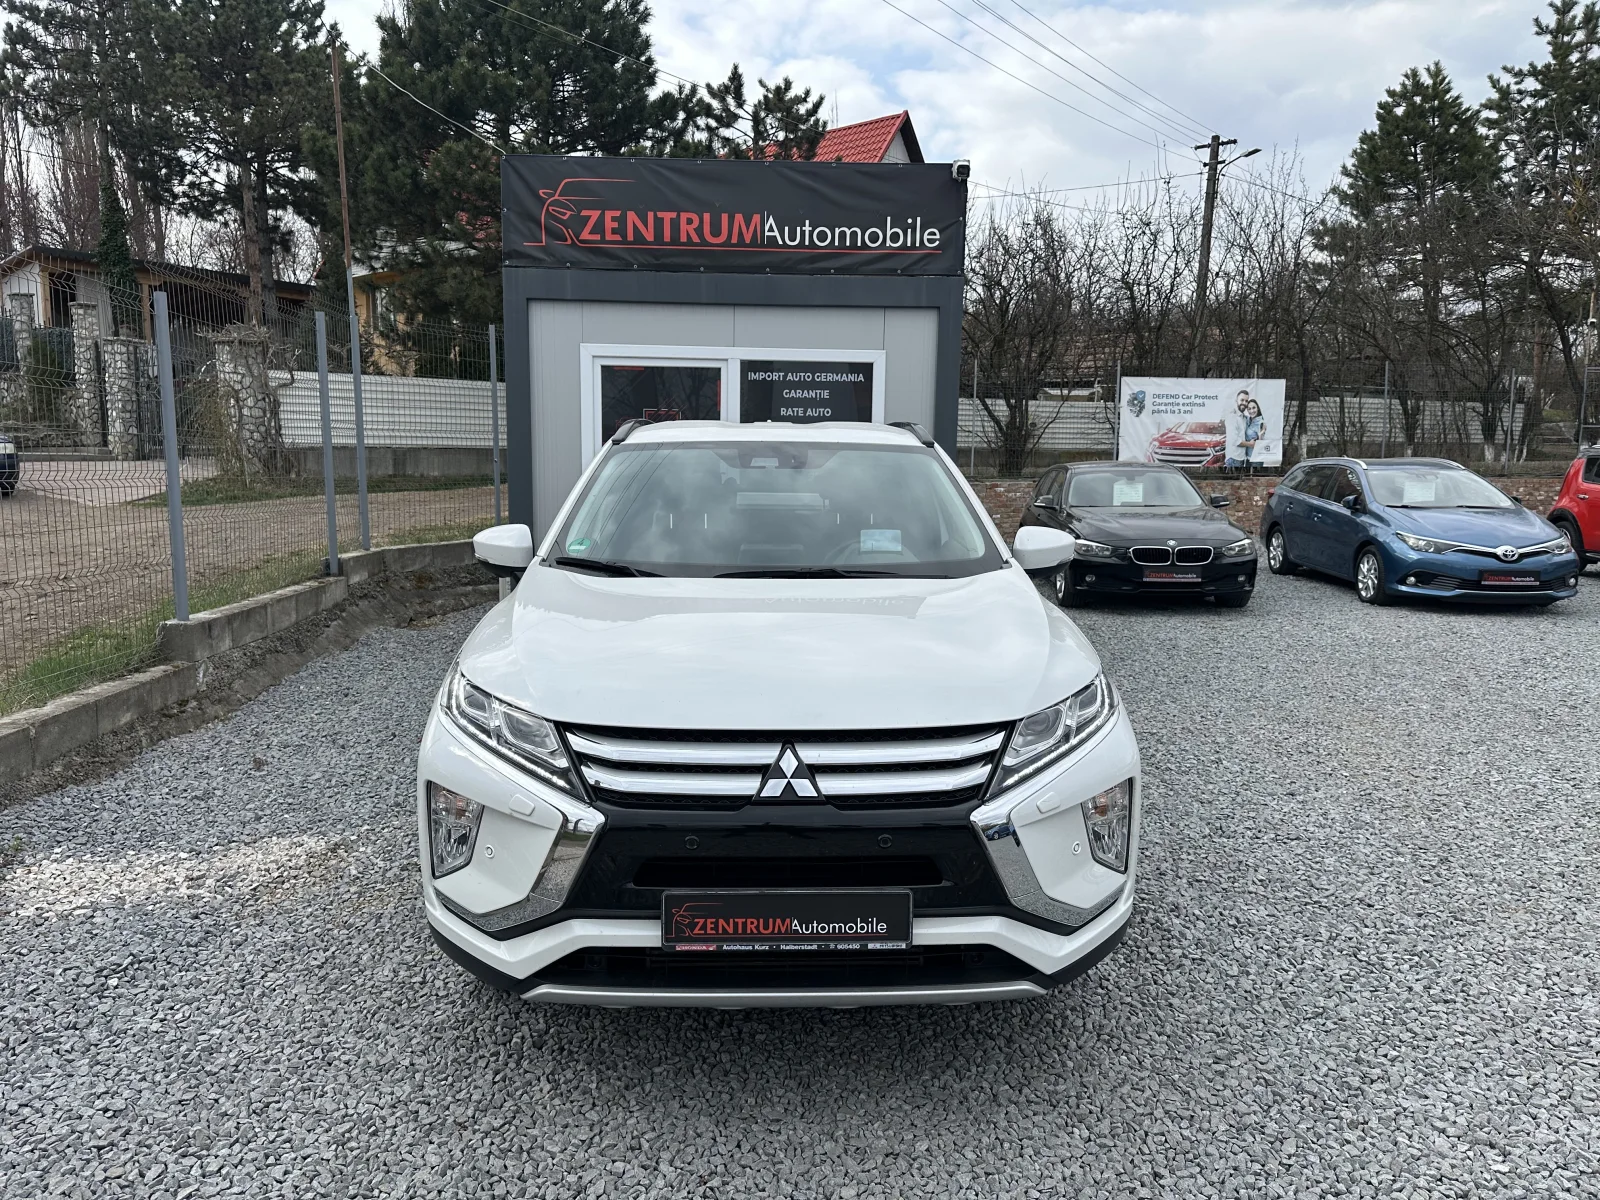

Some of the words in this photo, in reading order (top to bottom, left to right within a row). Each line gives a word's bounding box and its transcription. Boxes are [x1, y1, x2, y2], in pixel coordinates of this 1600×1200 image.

[748, 372, 784, 381] IMPORT
[786, 373, 812, 382] AUTO
[814, 373, 865, 382] GERMANIA
[780, 408, 804, 417] RATE
[806, 408, 832, 417] AUTO
